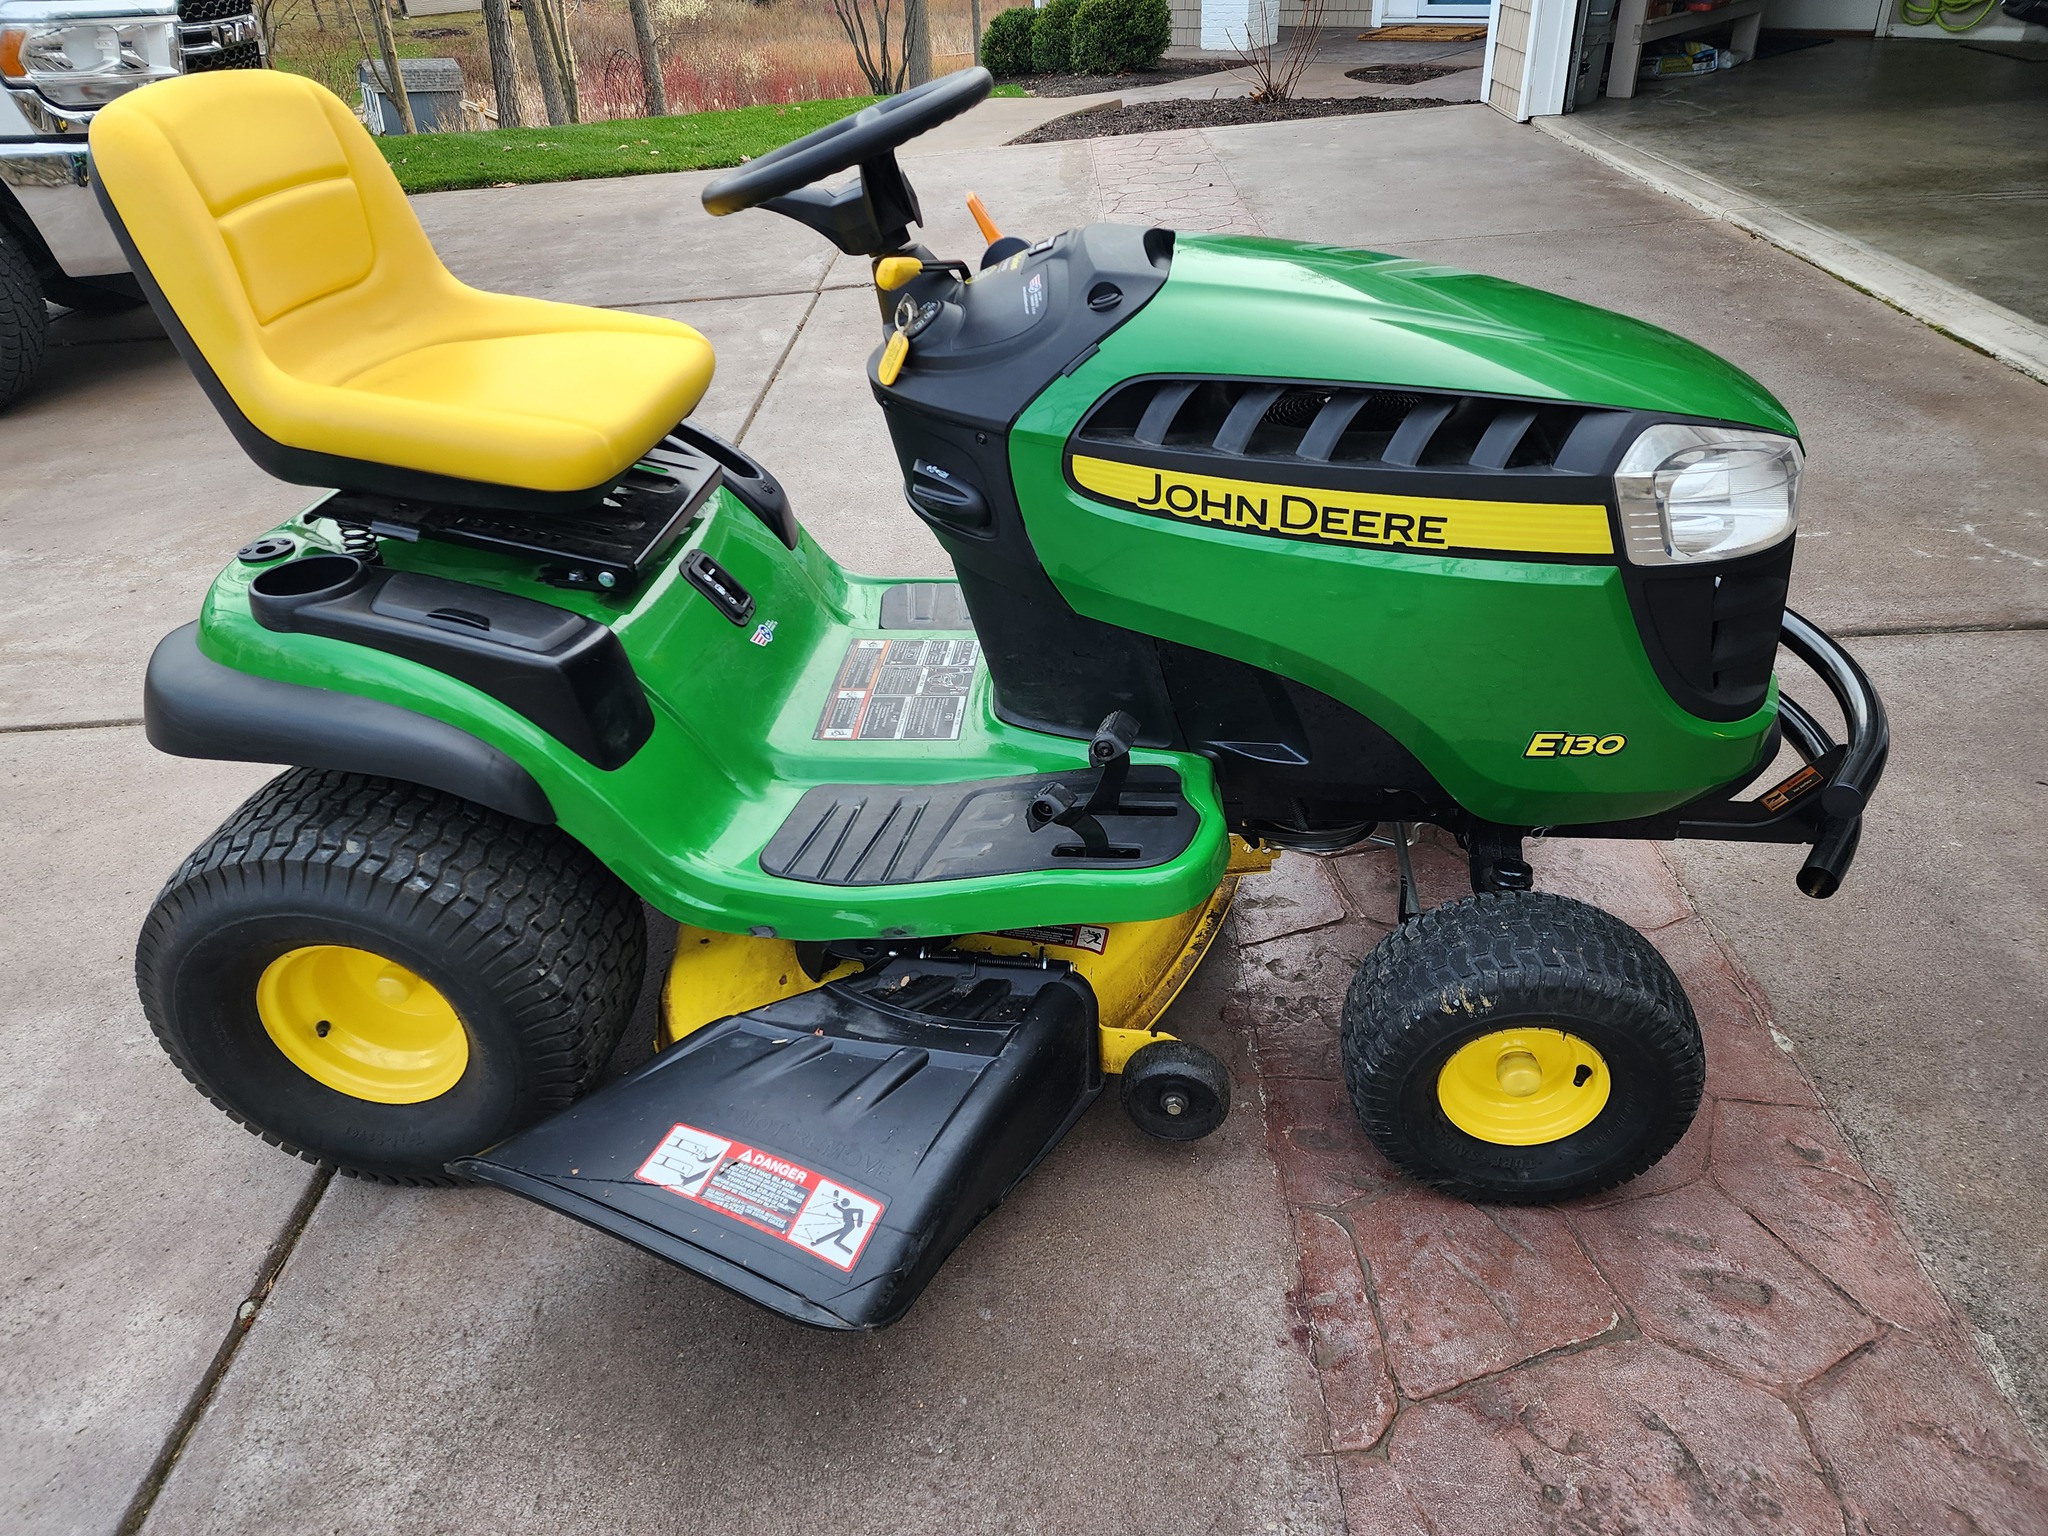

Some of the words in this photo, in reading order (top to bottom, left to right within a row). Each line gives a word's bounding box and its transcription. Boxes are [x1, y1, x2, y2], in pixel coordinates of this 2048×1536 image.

[1137, 473, 1267, 525] JOHN
[1281, 495, 1448, 545] DEERE
[1525, 733, 1626, 757] E130
[737, 1162, 772, 1179] ROTATING
[771, 1176, 795, 1189] BLADE
[751, 1153, 808, 1184] DANGER
[726, 1174, 756, 1190] THROWN
[756, 1187, 788, 1204] OBJECTS
